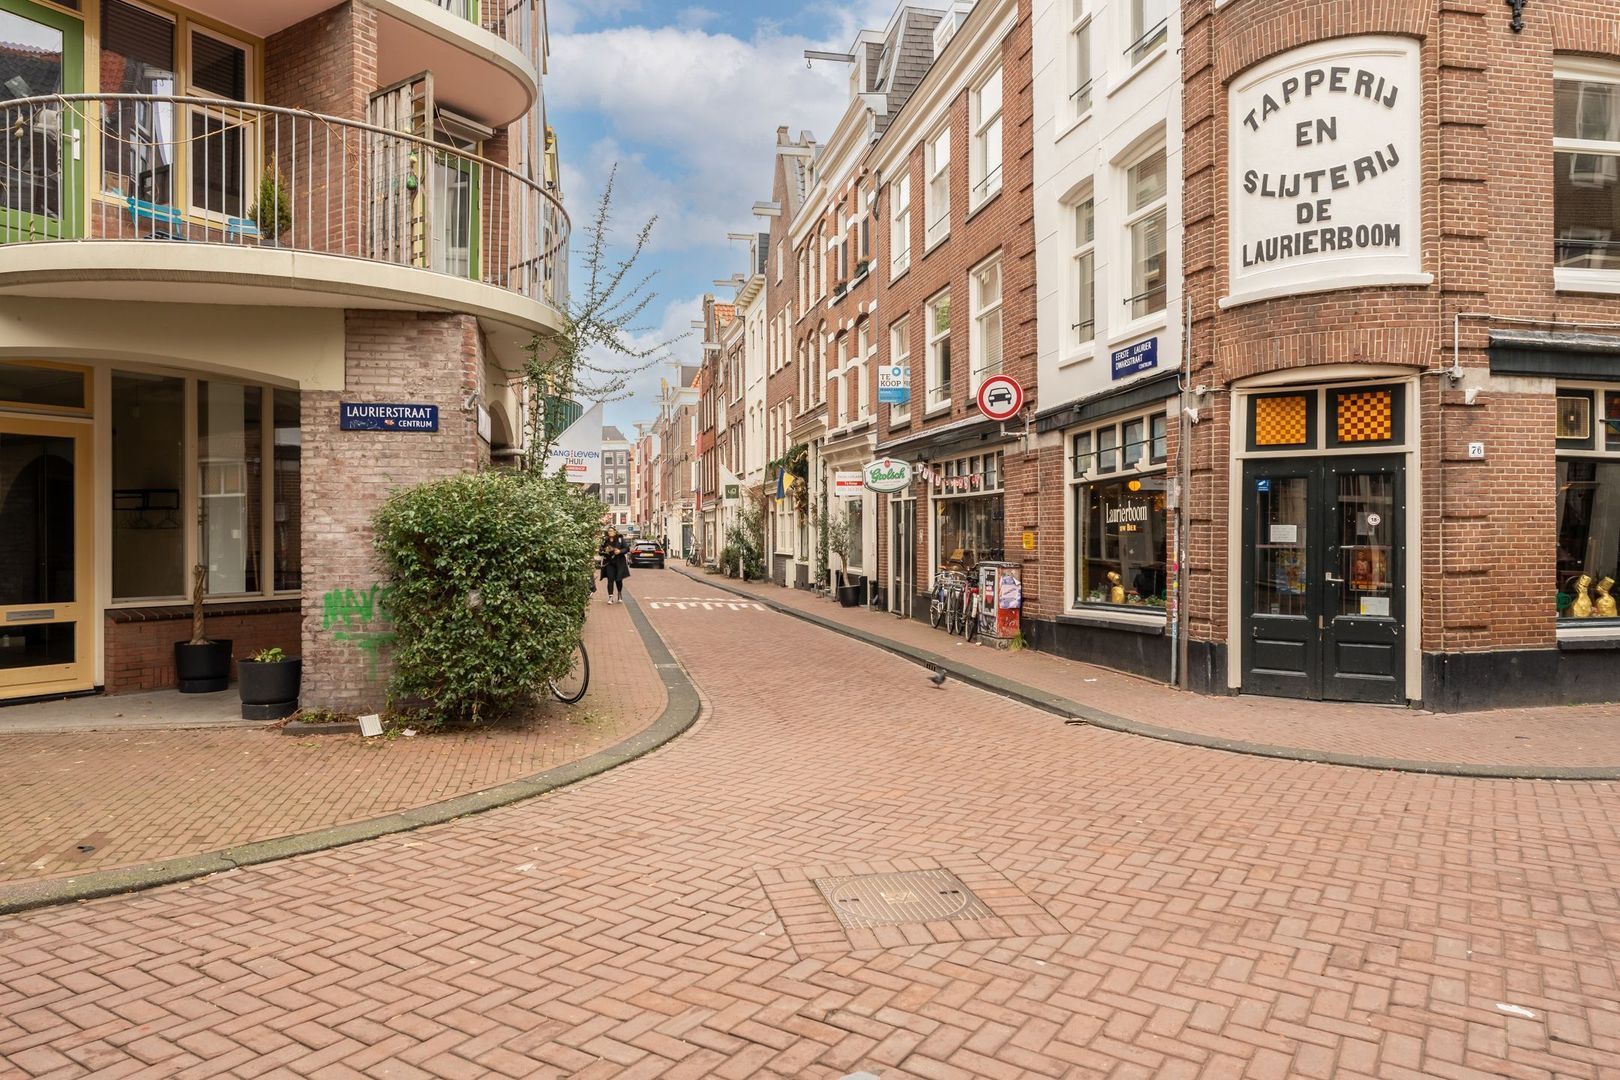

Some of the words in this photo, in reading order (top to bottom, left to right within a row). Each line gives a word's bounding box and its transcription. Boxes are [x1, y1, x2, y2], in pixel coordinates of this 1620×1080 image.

[1243, 66, 1399, 132] TAPPERIJ
[1296, 116, 1337, 147] EN
[1243, 143, 1400, 197] SLIJTERIJ
[1296, 198, 1332, 224] DE
[1243, 223, 1400, 267] LAURIERBOOM
[1115, 349, 1129, 361] EERSTE
[1134, 341, 1152, 354] LAURIER
[1115, 353, 1143, 370] DWARSSTRAAT
[346, 405, 432, 419] LAURIERSTRAAT
[398, 420, 433, 428] CENTRUM
[869, 466, 906, 483] Grolsch
[1105, 500, 1148, 524] Laurierboom
